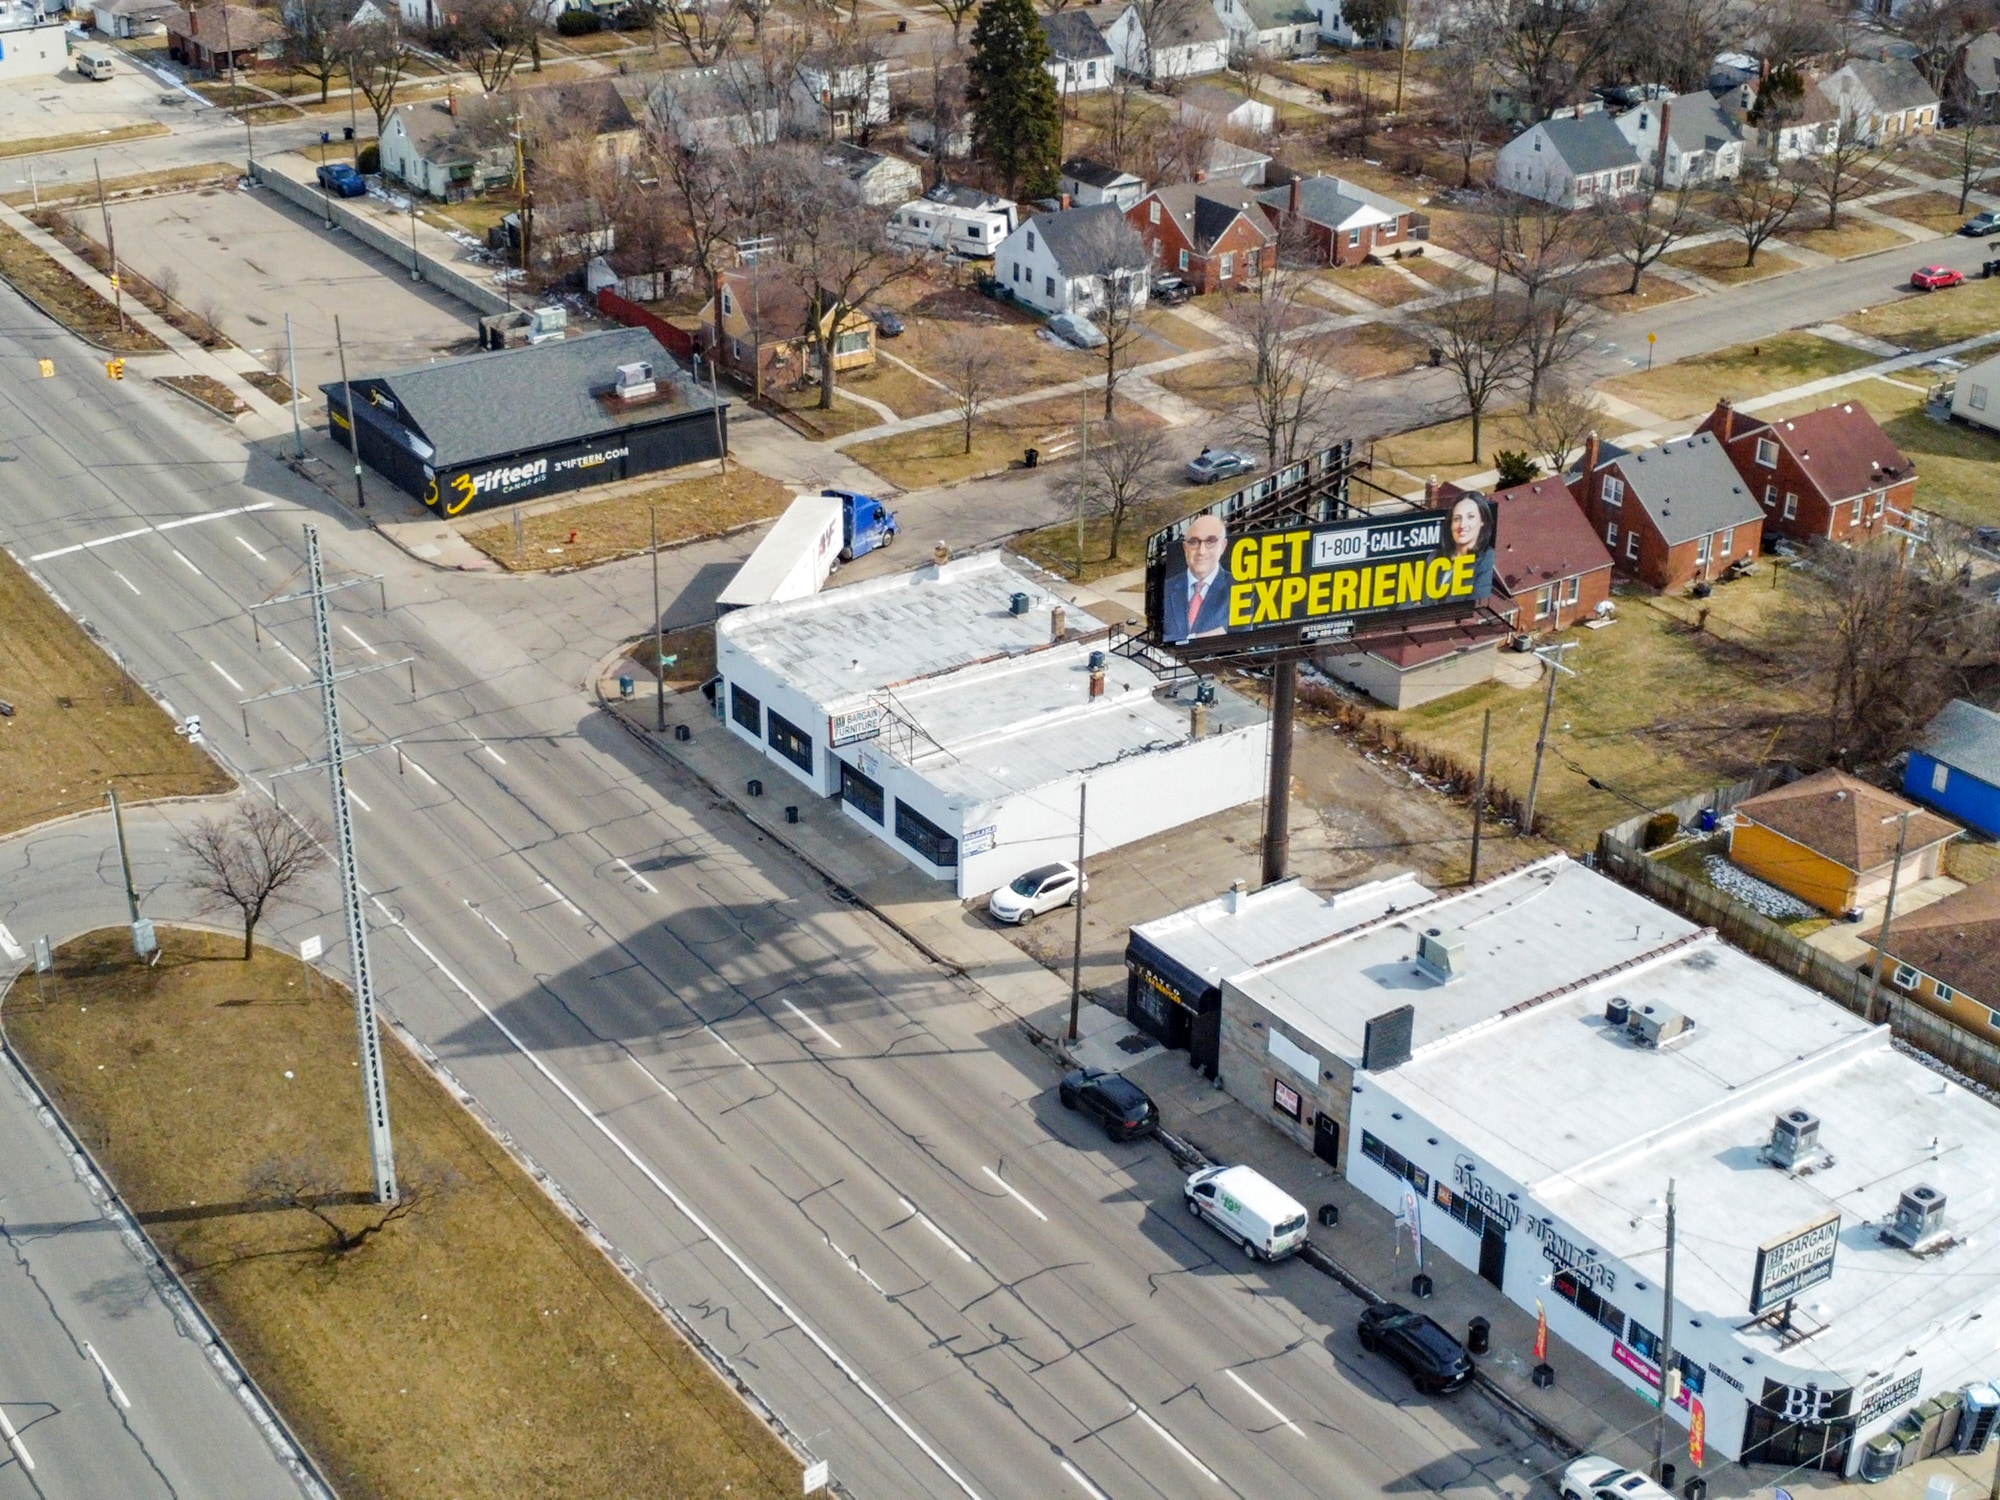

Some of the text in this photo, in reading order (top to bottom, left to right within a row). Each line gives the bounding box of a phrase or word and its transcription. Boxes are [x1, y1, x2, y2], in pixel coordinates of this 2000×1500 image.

[1230, 531, 1311, 582] GET
[1319, 525, 1442, 558] 1-800-CALL-SAM
[1229, 554, 1477, 627] EXPERIENCE
[835, 719, 877, 738] FURNITURE
[847, 708, 878, 724] BARGAIN
[1453, 1164, 1520, 1225] BARGAIN
[1525, 1213, 1616, 1293] FURNITURE
[1786, 1223, 1836, 1259] BARGAIN
[1765, 1243, 1832, 1285] FURNITURE
[1784, 1385, 1834, 1419] BF
